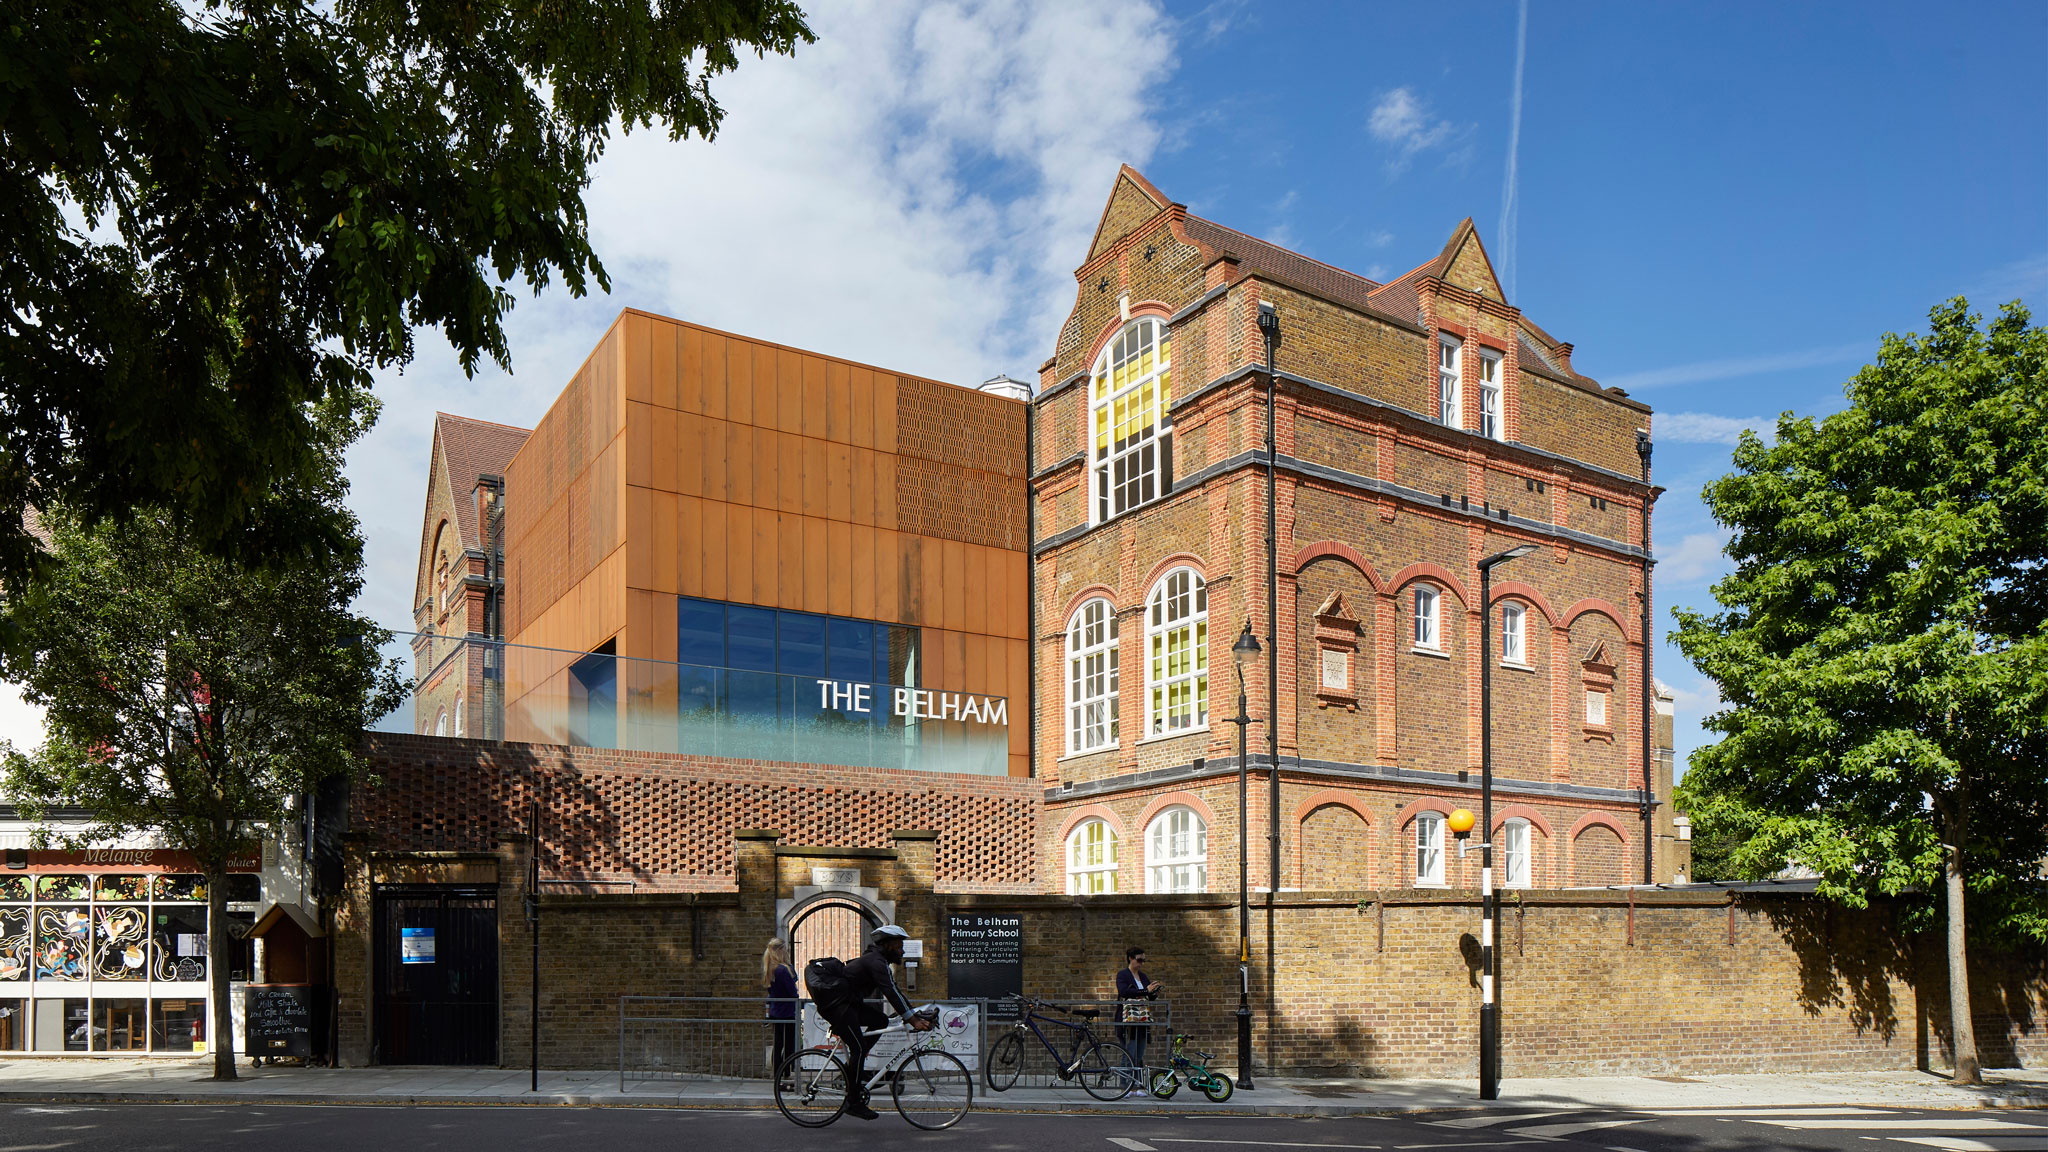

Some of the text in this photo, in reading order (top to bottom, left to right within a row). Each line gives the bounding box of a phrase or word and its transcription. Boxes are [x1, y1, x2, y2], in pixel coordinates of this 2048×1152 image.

[816, 679, 1008, 726] THE BELHAM
[820, 870, 854, 883] BOYS
[950, 917, 1019, 926] The Belham
[951, 928, 1019, 939] Primary School
